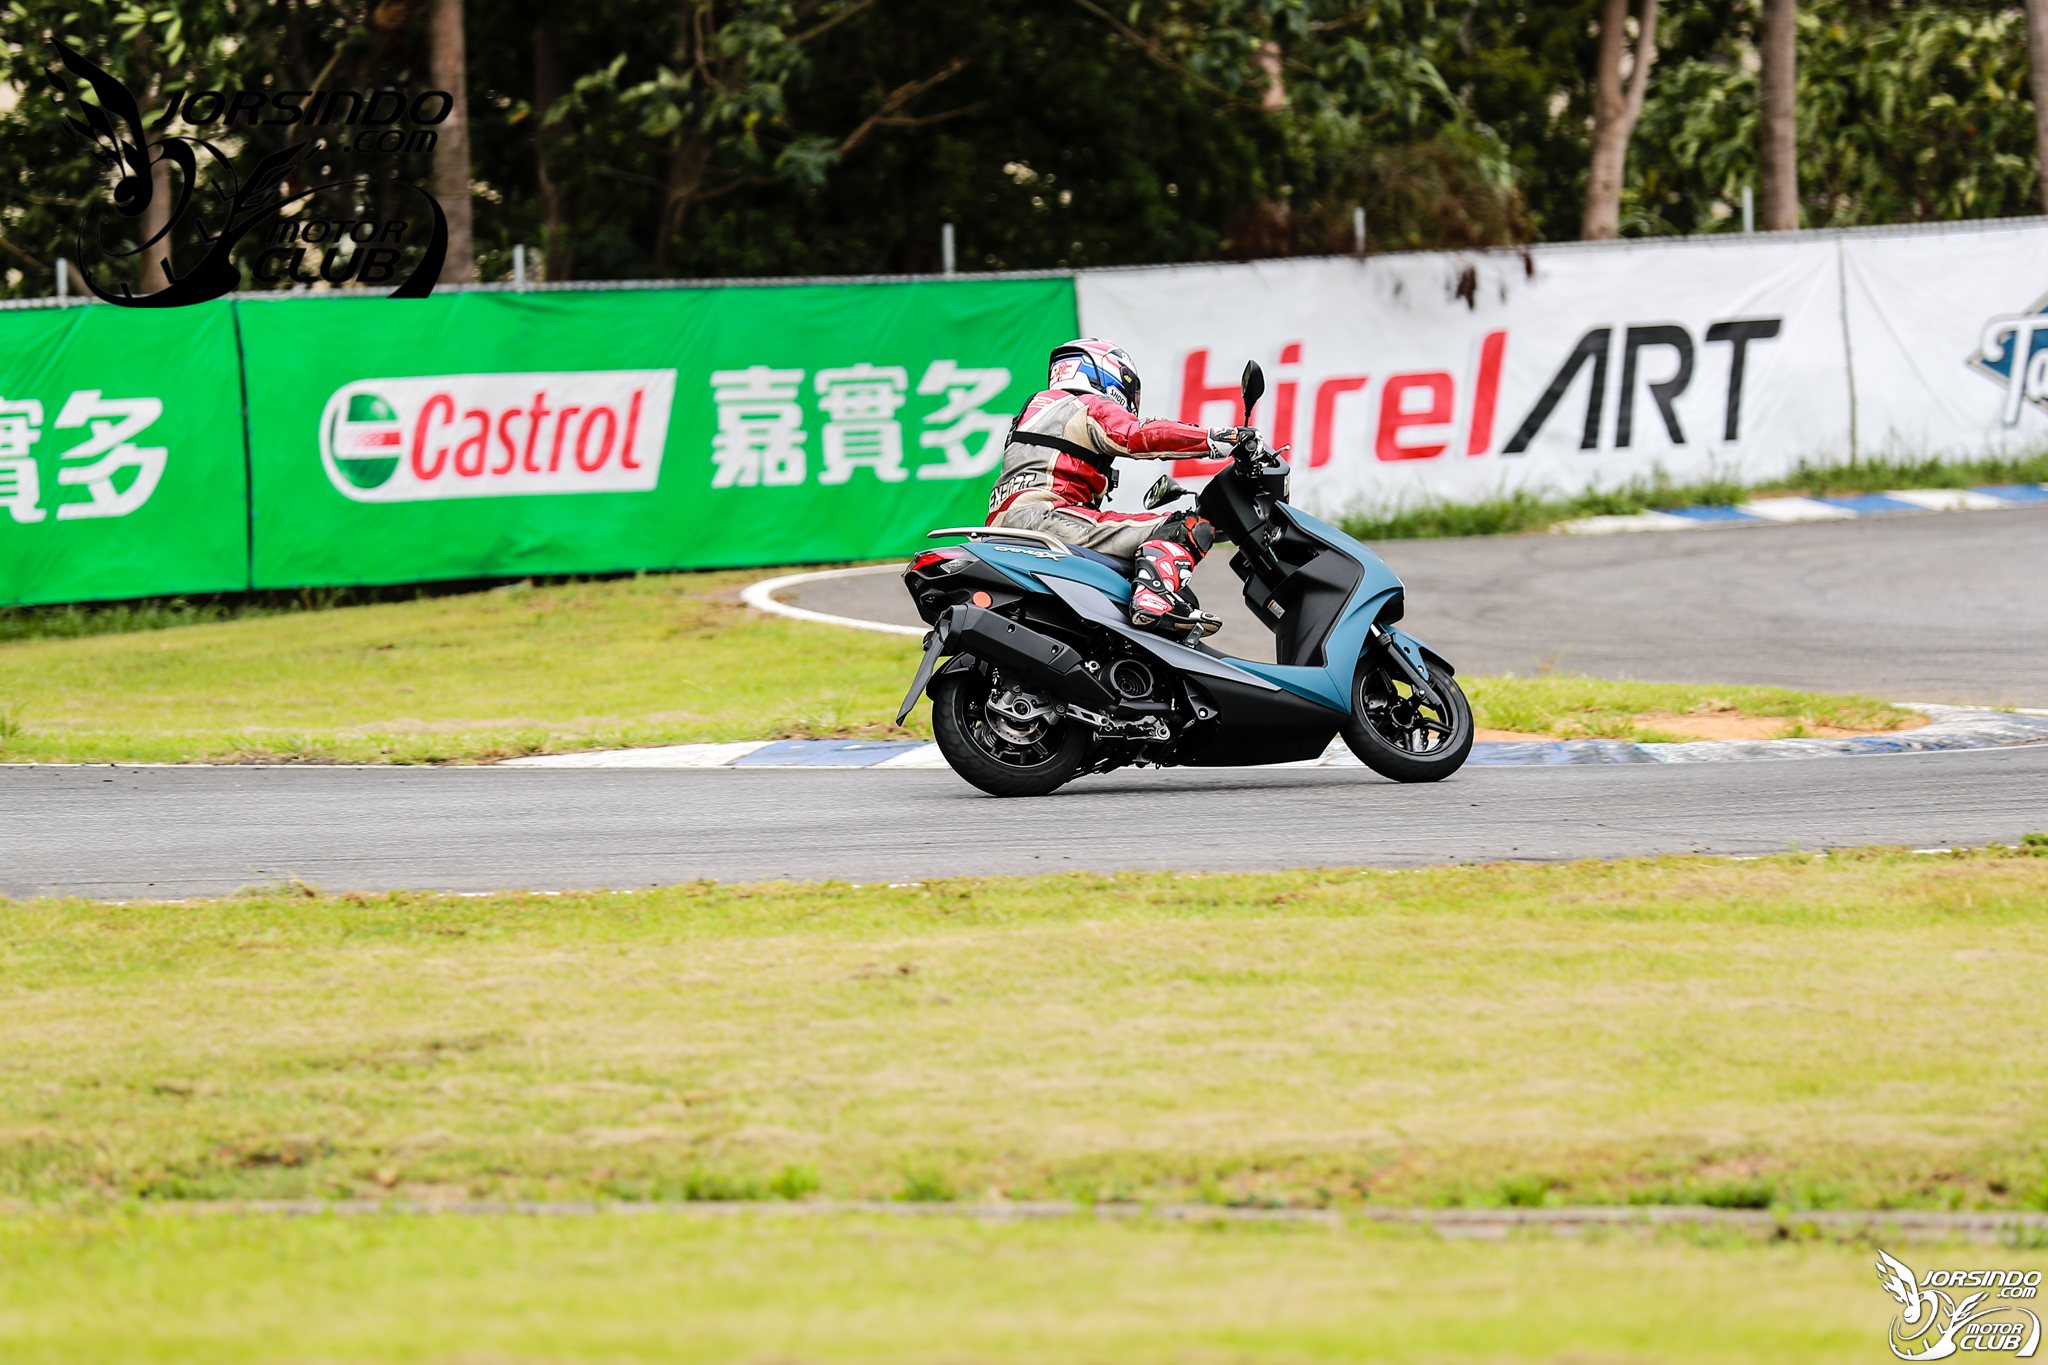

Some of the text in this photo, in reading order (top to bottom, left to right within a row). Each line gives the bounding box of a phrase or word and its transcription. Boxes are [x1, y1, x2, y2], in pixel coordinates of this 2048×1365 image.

[410, 388, 645, 481] Castrol
[710, 358, 1013, 490] 嘉實多
